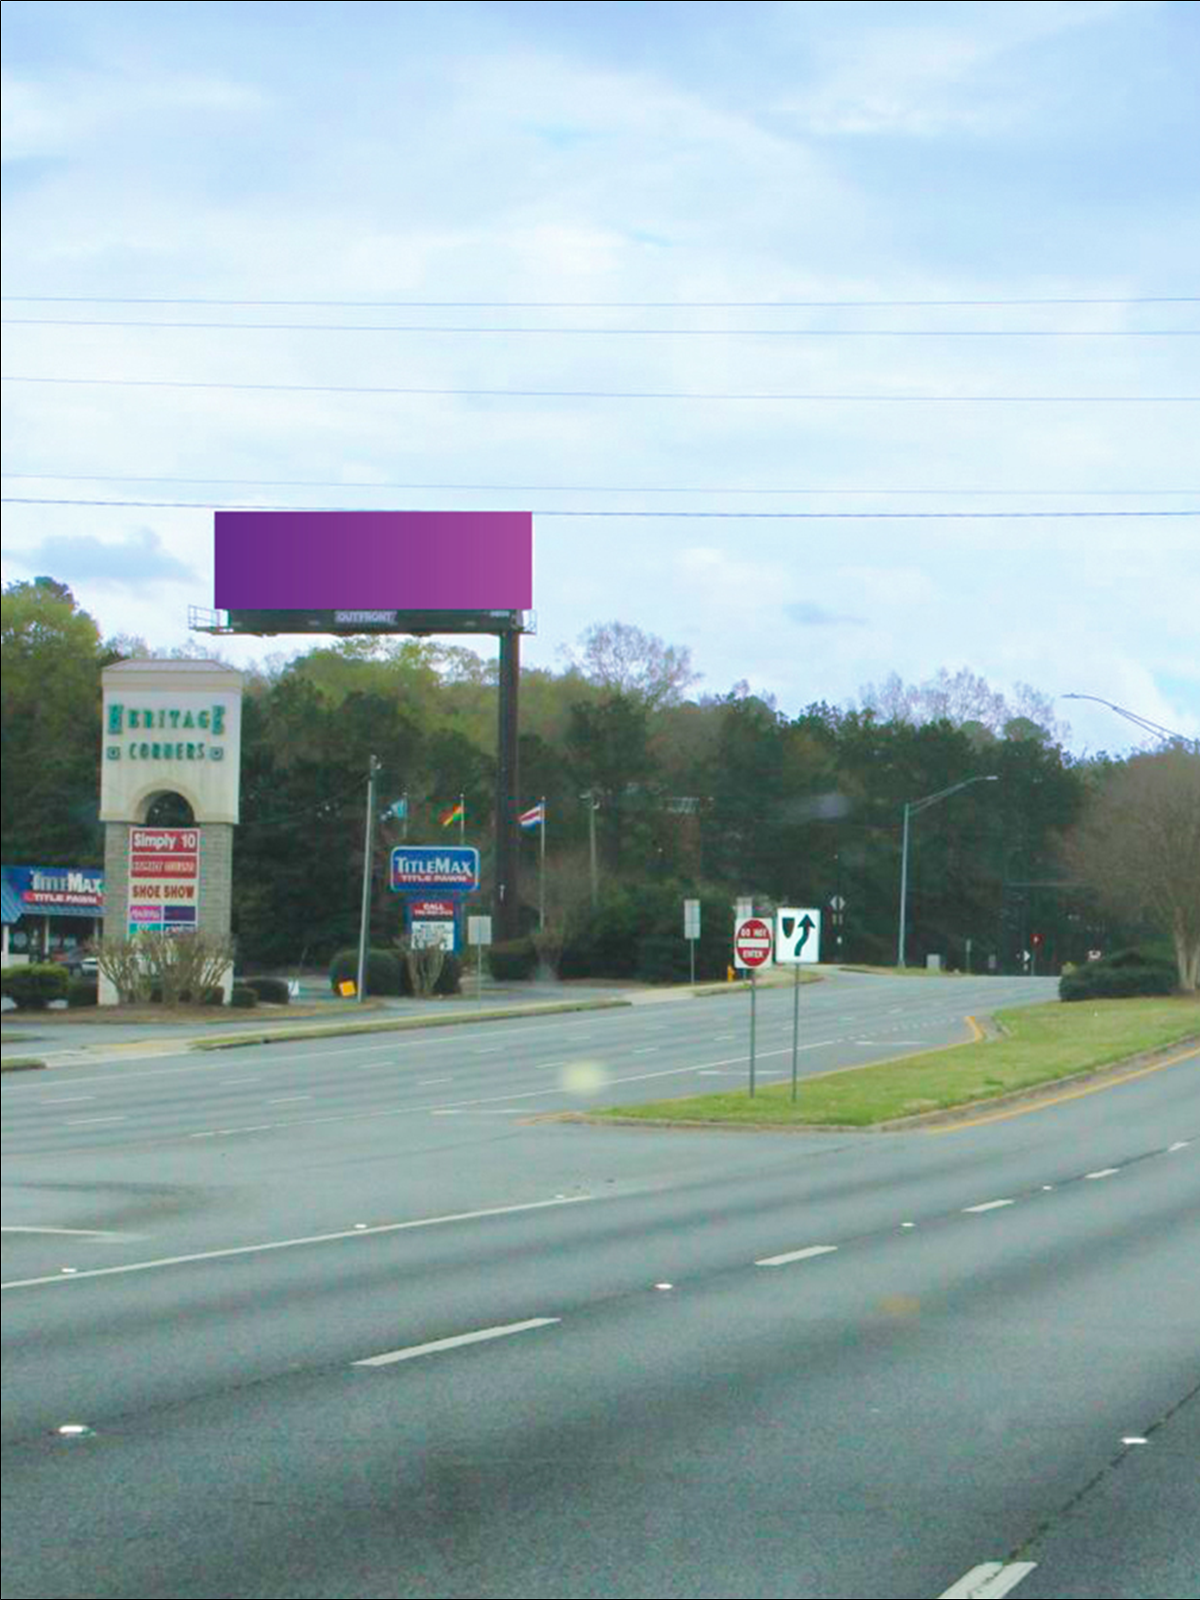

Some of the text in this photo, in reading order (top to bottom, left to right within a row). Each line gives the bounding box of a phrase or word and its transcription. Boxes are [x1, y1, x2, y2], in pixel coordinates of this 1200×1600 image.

[338, 611, 393, 623] OUTFRONT
[107, 703, 225, 735] HERITAGE
[129, 742, 205, 760] CORNERS
[134, 833, 196, 850] Simply 10
[34, 893, 63, 903] TITLE
[132, 884, 196, 899] SHOE SHOW
[741, 928, 767, 937] DO NOT
[743, 950, 763, 958] ENTER
